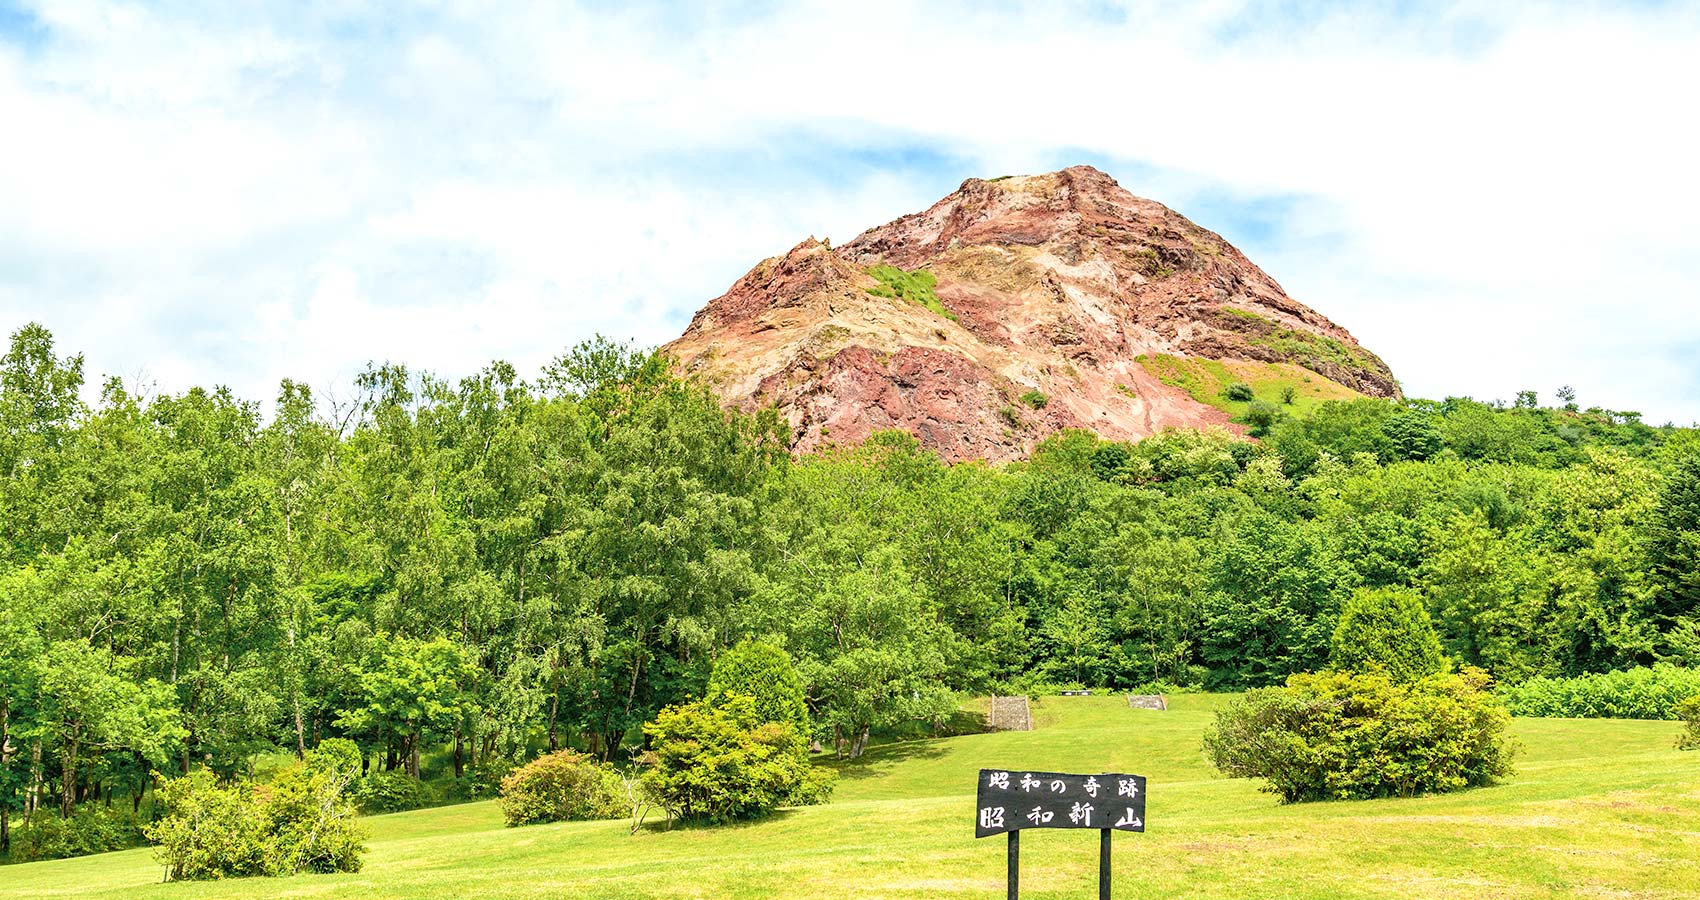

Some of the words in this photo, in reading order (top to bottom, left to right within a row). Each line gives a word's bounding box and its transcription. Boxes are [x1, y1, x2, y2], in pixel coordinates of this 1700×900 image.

[988, 772, 1139, 798] 昭和の奇跡
[980, 801, 1143, 829] 昭和新山
